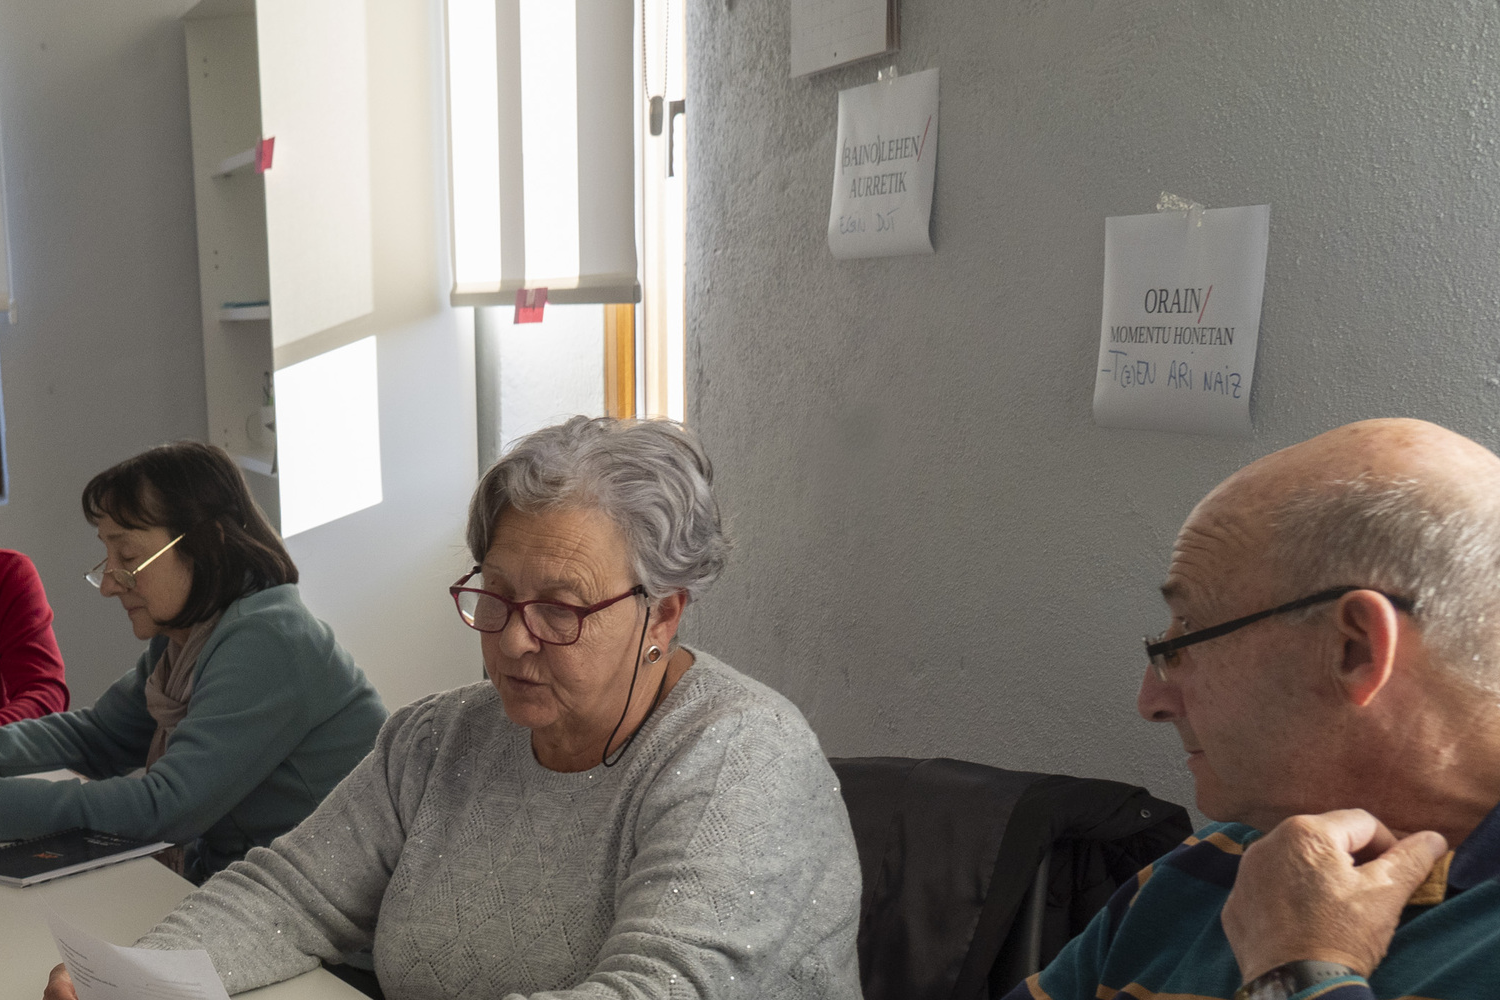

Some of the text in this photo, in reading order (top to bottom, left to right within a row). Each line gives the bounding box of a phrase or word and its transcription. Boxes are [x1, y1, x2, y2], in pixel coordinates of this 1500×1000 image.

[849, 171, 907, 199] AURRETIK
[1110, 326, 1235, 346] MOMENTU HONETAN
